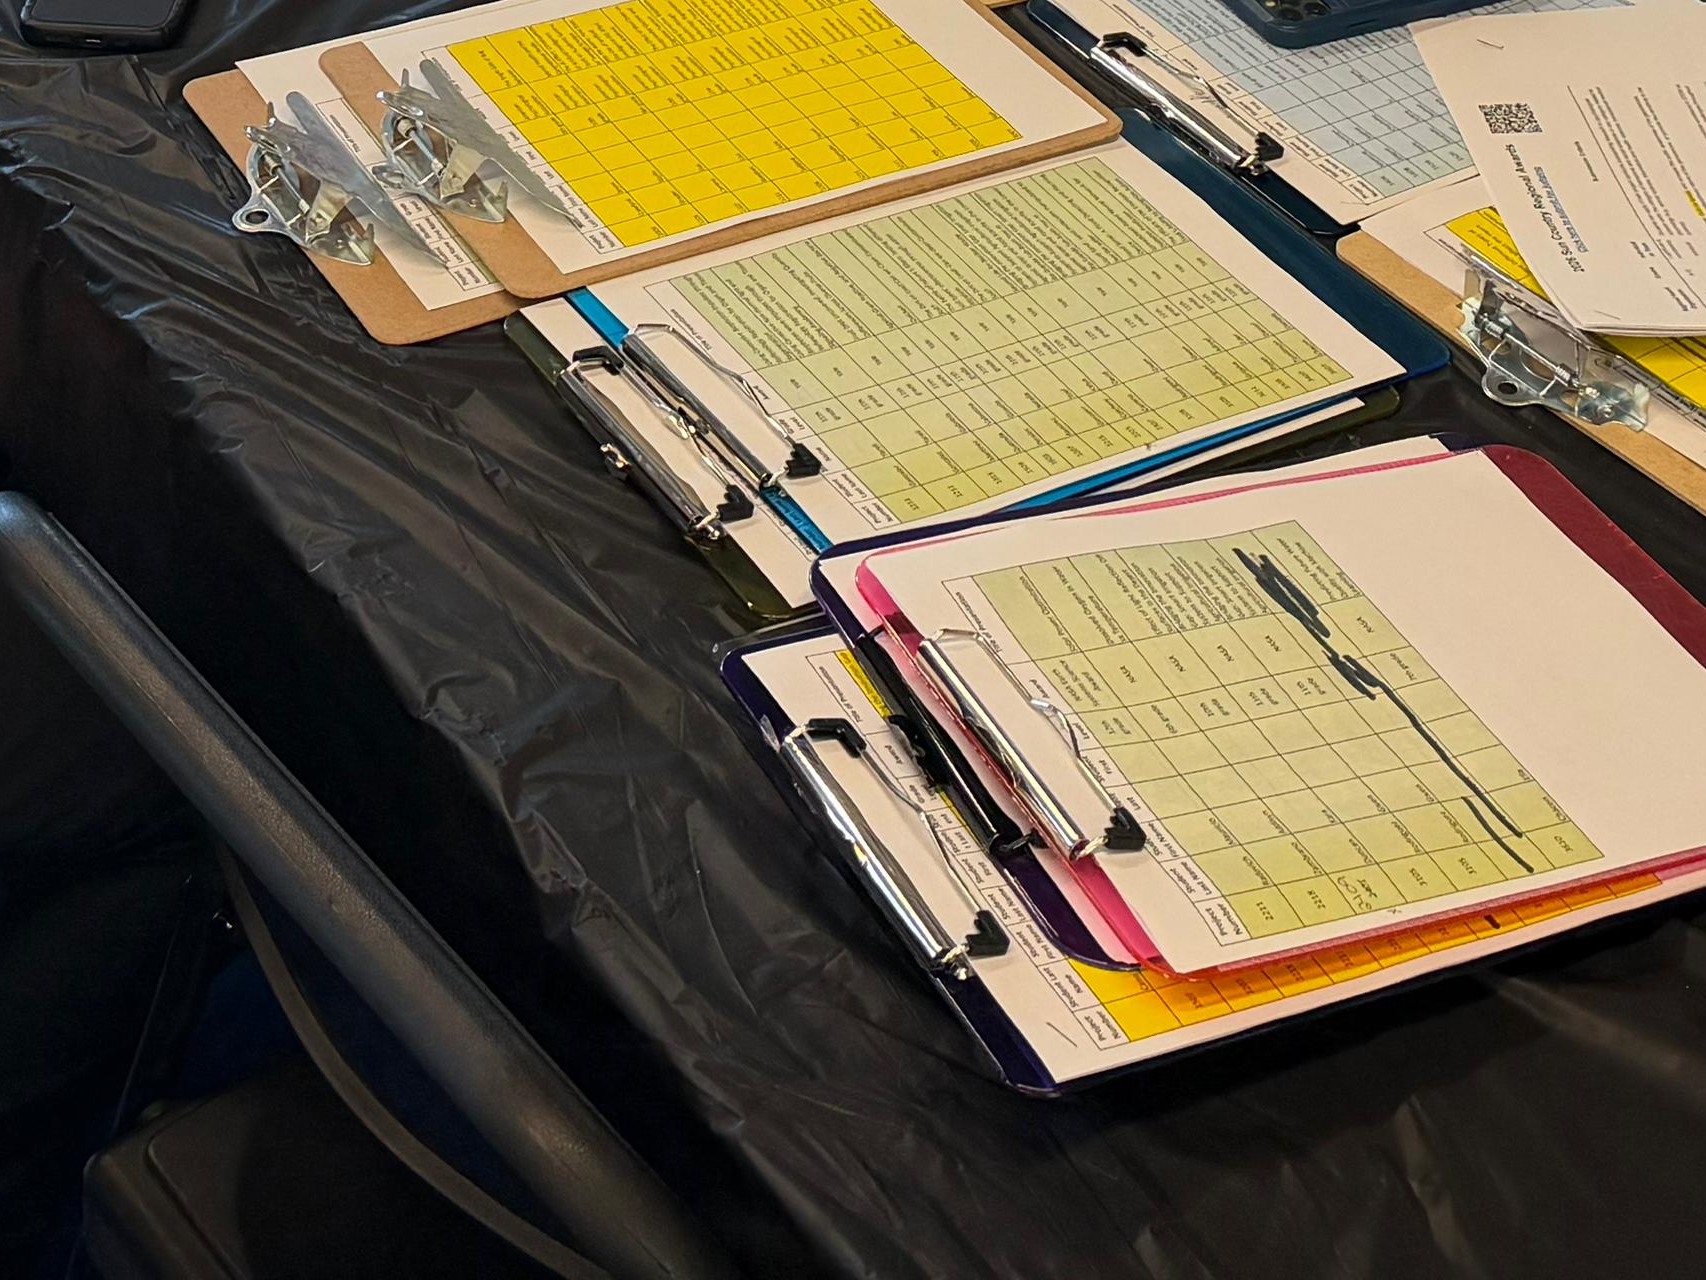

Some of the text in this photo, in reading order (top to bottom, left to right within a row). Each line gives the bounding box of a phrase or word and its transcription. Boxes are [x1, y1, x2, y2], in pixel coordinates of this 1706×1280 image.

[1504, 143, 1526, 174] Awards
[1517, 174, 1545, 209] Regional
[1539, 210, 1563, 241] Country
[1557, 240, 1573, 256] Sun
[1291, 553, 1311, 573] Future
[1104, 562, 1130, 593] Reflection
[1120, 568, 1140, 589] Desert
[1163, 571, 1186, 596] Support
[1051, 565, 1115, 645] Dissolved Oxygen in Water
[1126, 593, 1143, 610] Light
[1136, 588, 1149, 601] the
[1182, 594, 1193, 604] to
[954, 590, 986, 631] Presentation
[1087, 594, 1123, 634] Temperature
[1137, 608, 1149, 617] of
[981, 630, 993, 638] of
[1046, 615, 1065, 636] Power
[1355, 615, 1374, 633] NASA
[1167, 654, 1186, 673] NASA
[1216, 643, 1235, 662] NASA
[818, 665, 849, 705] Presentation
[1118, 664, 1136, 684] NASA
[1028, 678, 1050, 699] Award
[850, 709, 863, 723] Title
[1149, 703, 1170, 722] grade
[1071, 721, 1090, 740] Level
[883, 744, 903, 765] Award
[1097, 758, 1113, 775] First
[1125, 795, 1141, 811] Last
[1147, 822, 1180, 858] First Name
[960, 857, 985, 884] Student
[976, 860, 992, 877] First
[1179, 860, 1213, 896] Last Name
[1168, 867, 1196, 895] Student
[989, 896, 1011, 920] Student
[997, 886, 1027, 922] Last Name
[1204, 906, 1228, 936] Project
[1216, 902, 1243, 935] Number
[1018, 934, 1040, 958] Student
[1025, 923, 1056, 960] First Name
[1042, 966, 1079, 1008] Student Last
[1064, 973, 1083, 994] Name
[1083, 1014, 1107, 1042] Project
[1095, 1010, 1121, 1040] Number
